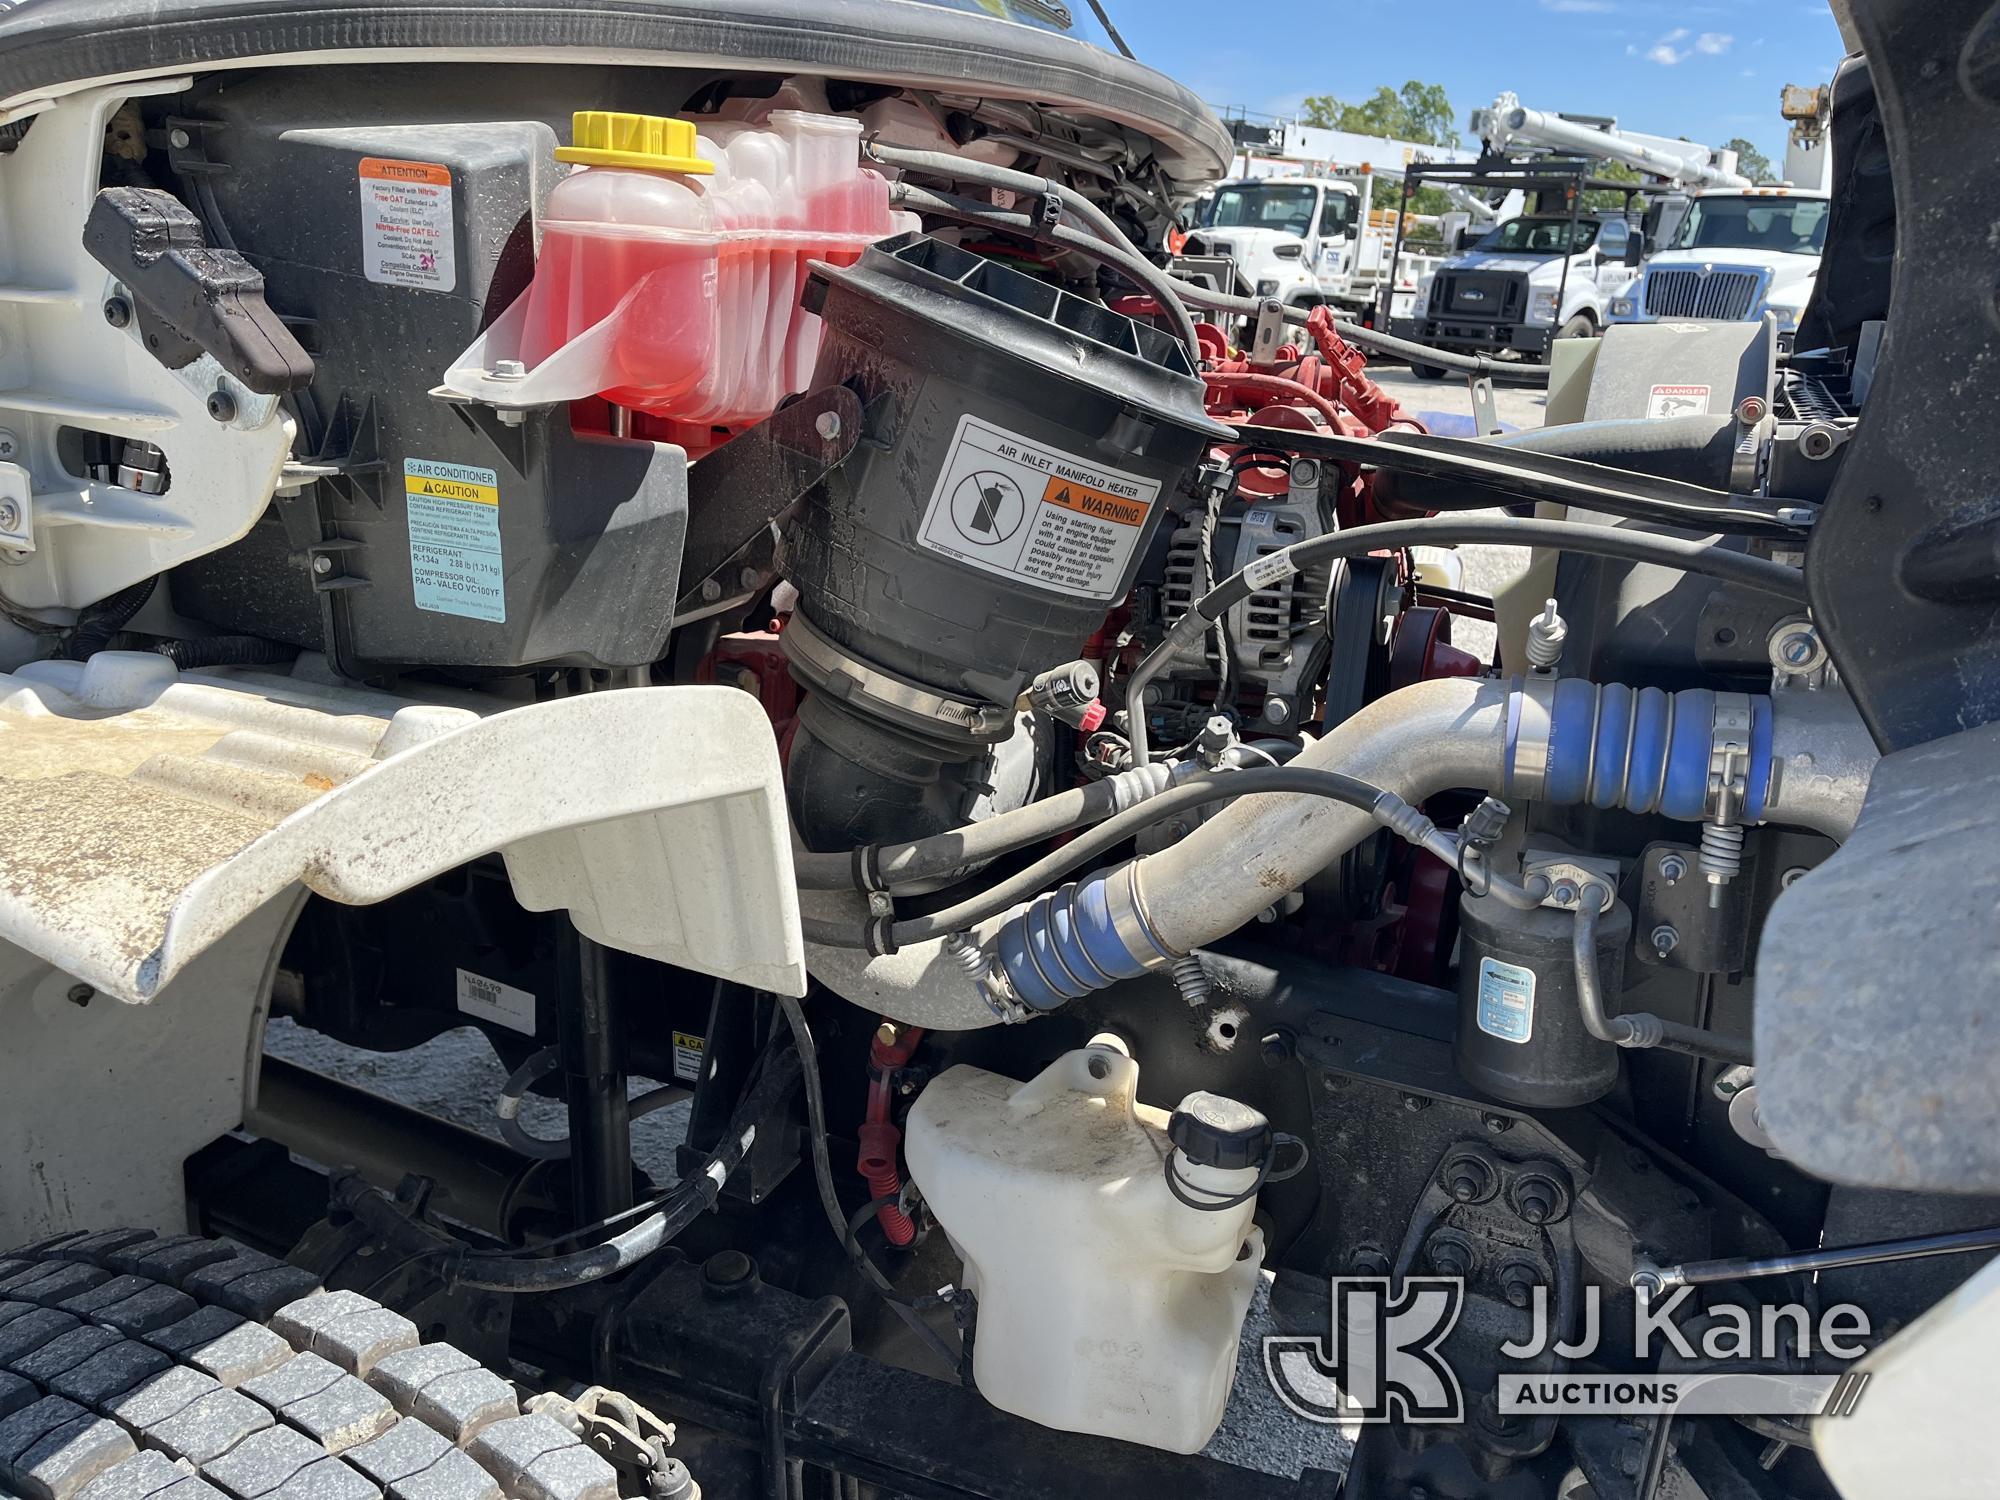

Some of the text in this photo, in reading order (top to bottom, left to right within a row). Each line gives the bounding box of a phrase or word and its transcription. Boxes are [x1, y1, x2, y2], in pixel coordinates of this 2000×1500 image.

[382, 166, 428, 178] ATTENTION
[372, 184, 390, 192] Factory
[375, 193, 388, 202] Free
[390, 194, 404, 203] OAT
[410, 207, 424, 216] (ELC)
[376, 222, 440, 238] Nitrite-Free OAT ELC
[422, 220, 434, 228] Only
[378, 242, 410, 250] Conventional
[381, 260, 412, 270] Compatible
[417, 464, 494, 484] AIR CONDITIONER
[997, 444, 1138, 497] AIR INLET MANIFOLD HEATER
[434, 483, 479, 499] CAUTION
[409, 495, 431, 504] CAUTION
[446, 500, 472, 510] PRESSURE
[409, 502, 435, 511] CONTAINS
[436, 506, 471, 516] REFRIGERANT
[1082, 494, 1140, 522] WARNING
[440, 524, 461, 532] SISTEMA
[1046, 510, 1112, 536] Using starting fluid
[411, 526, 433, 536] CONTIENE
[434, 530, 469, 540] REFRIGERANTE
[1066, 528, 1088, 539] engine
[1090, 534, 1116, 546] equipped
[1034, 538, 1056, 549] could
[1058, 545, 1077, 556] cause
[1038, 530, 1054, 539] with
[1064, 537, 1092, 550] manifold
[1093, 544, 1110, 553] heater
[412, 544, 464, 558] REFRIGERANT:
[1030, 547, 1062, 562] possibly
[1065, 557, 1093, 570] resulting
[413, 554, 439, 565] R-134a
[450, 559, 500, 576] 2.88 lb (1.31 kg)
[414, 568, 479, 584] COMPRESSOR OIL:
[1024, 565, 1090, 587] and engine damage.
[1028, 556, 1102, 580] severe personal injury
[415, 576, 432, 586] PAG
[436, 580, 464, 591] VALEO
[466, 584, 500, 597] VC100YF
